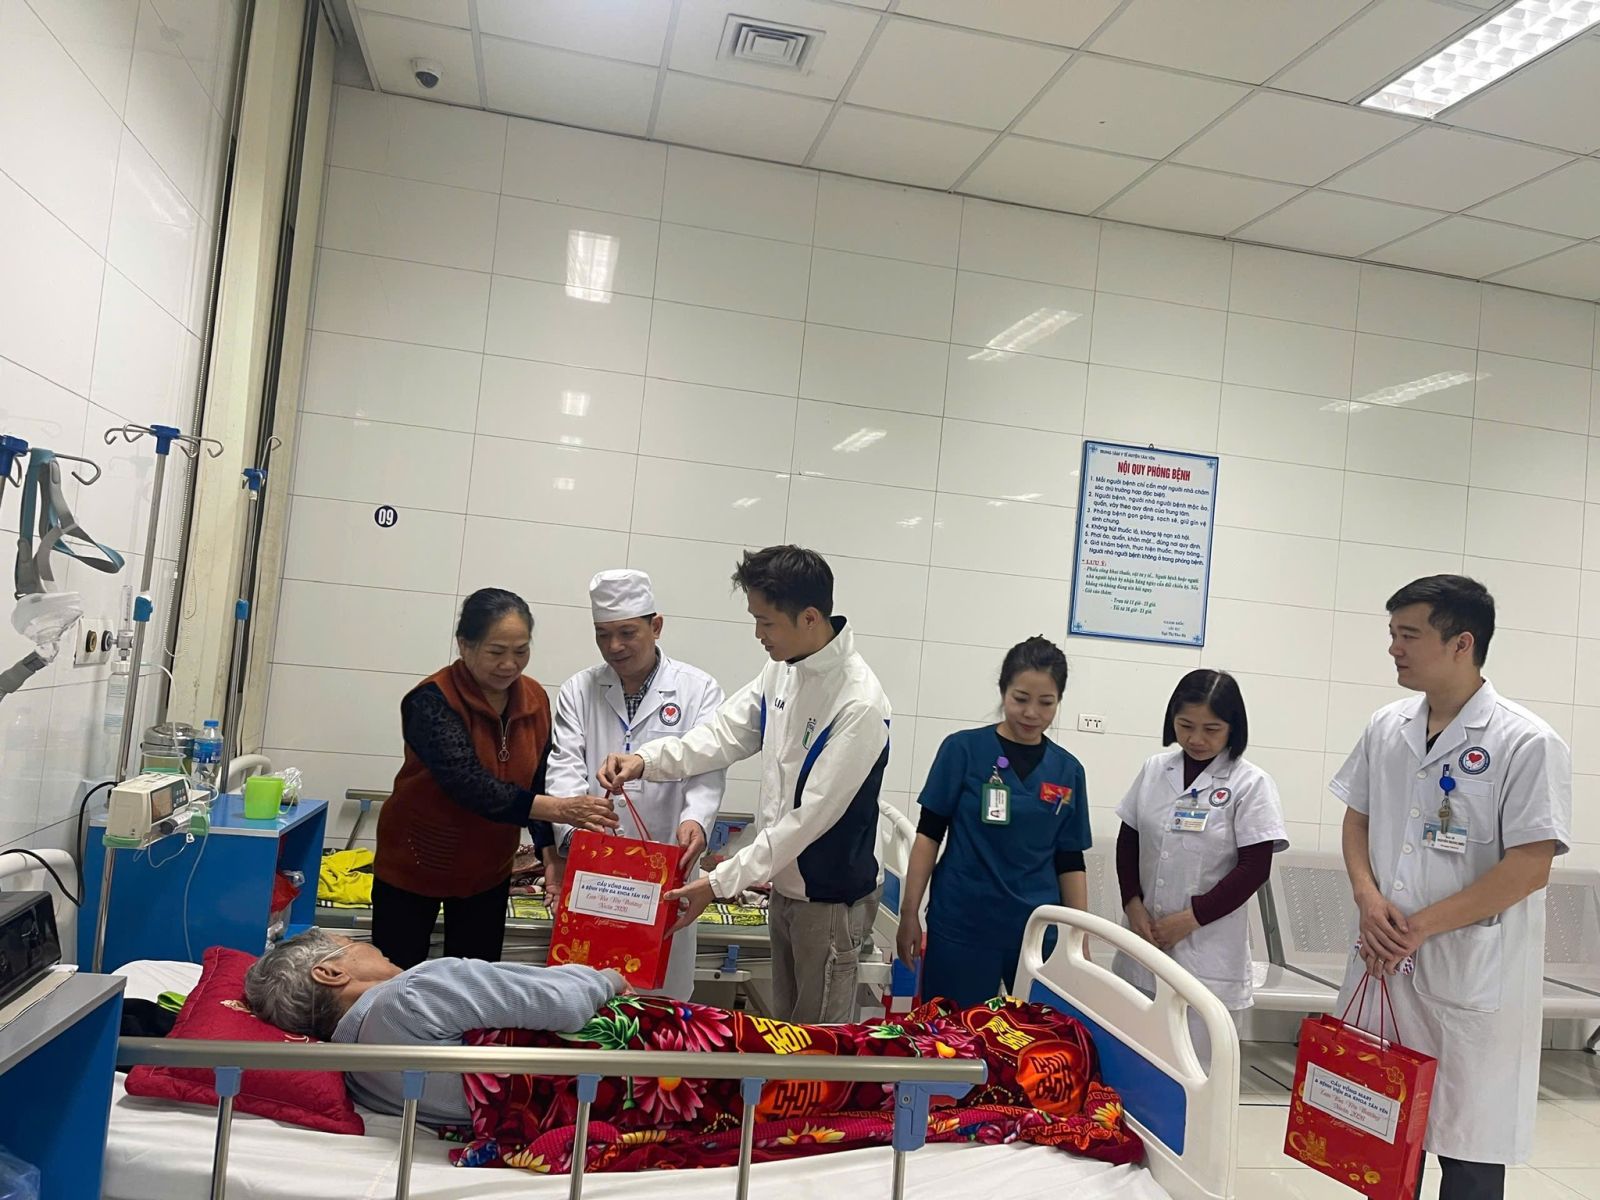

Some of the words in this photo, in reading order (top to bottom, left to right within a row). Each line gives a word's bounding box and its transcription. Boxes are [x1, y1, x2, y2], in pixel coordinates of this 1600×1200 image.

[1118, 460, 1130, 475] NỘI
[1132, 464, 1146, 475] QUY
[1172, 467, 1190, 482] BỆNH
[379, 508, 394, 526] 09
